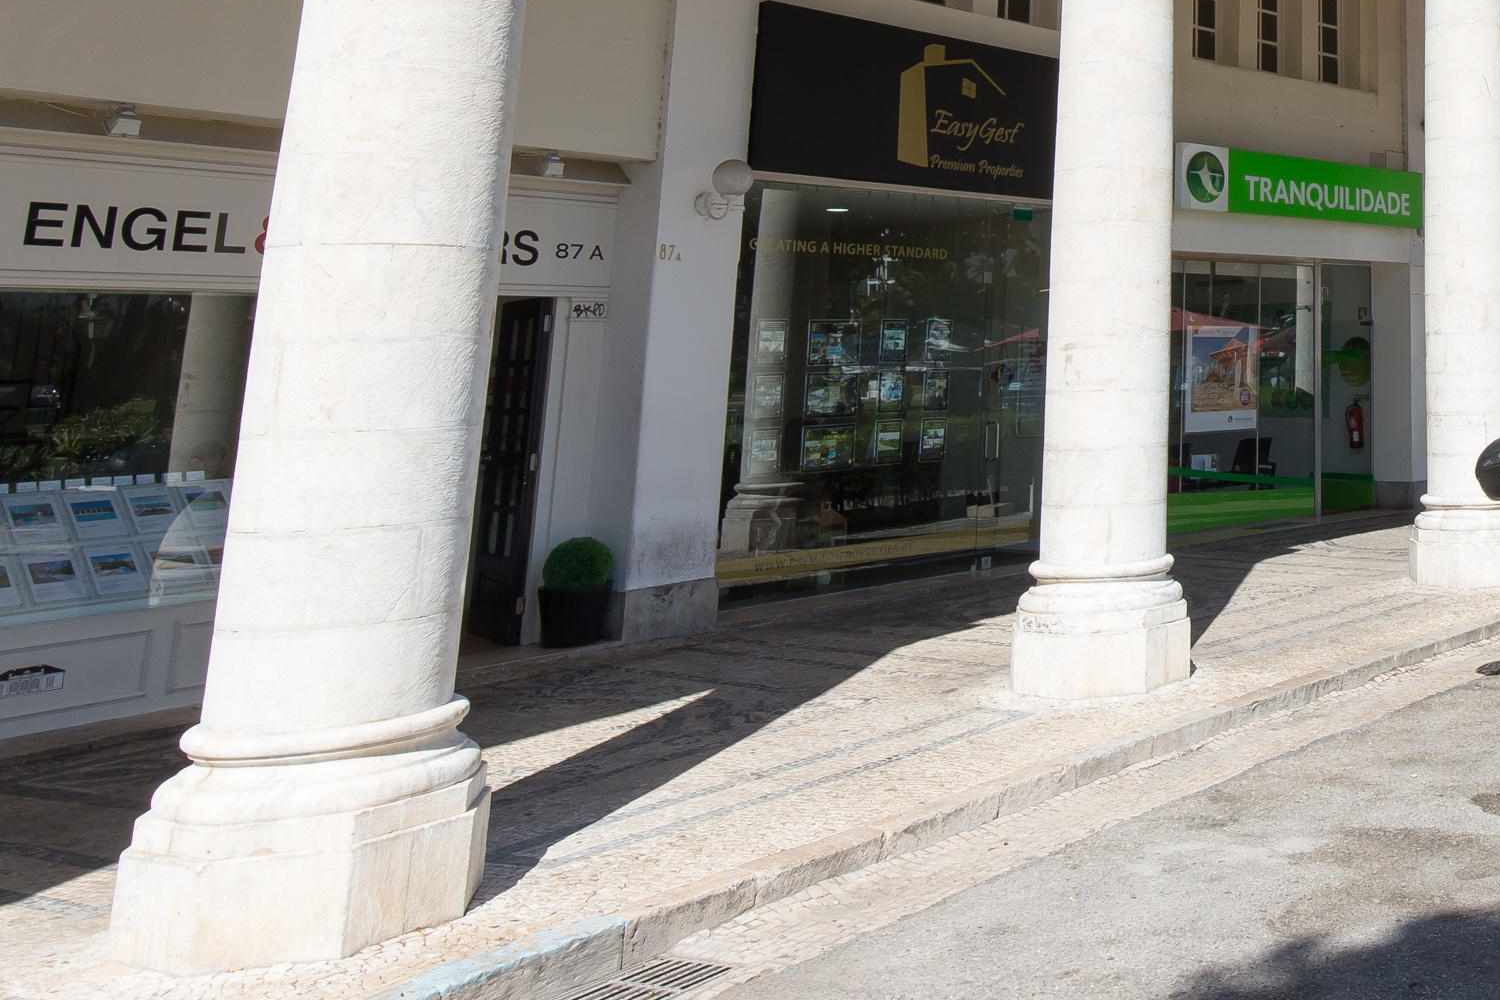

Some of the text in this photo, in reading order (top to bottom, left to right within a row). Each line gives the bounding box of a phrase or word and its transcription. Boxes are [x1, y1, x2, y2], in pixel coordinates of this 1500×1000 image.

[930, 109, 1025, 152] EasyGest
[930, 153, 1024, 180] Premium Properties
[1244, 175, 1411, 217] TRANQUILIDADE
[23, 201, 246, 254] ENGEL
[555, 243, 584, 260] 87
[589, 245, 604, 260] A
[820, 240, 830, 254] A
[833, 242, 881, 257] HIGHER
[884, 244, 948, 260] STANDARD
